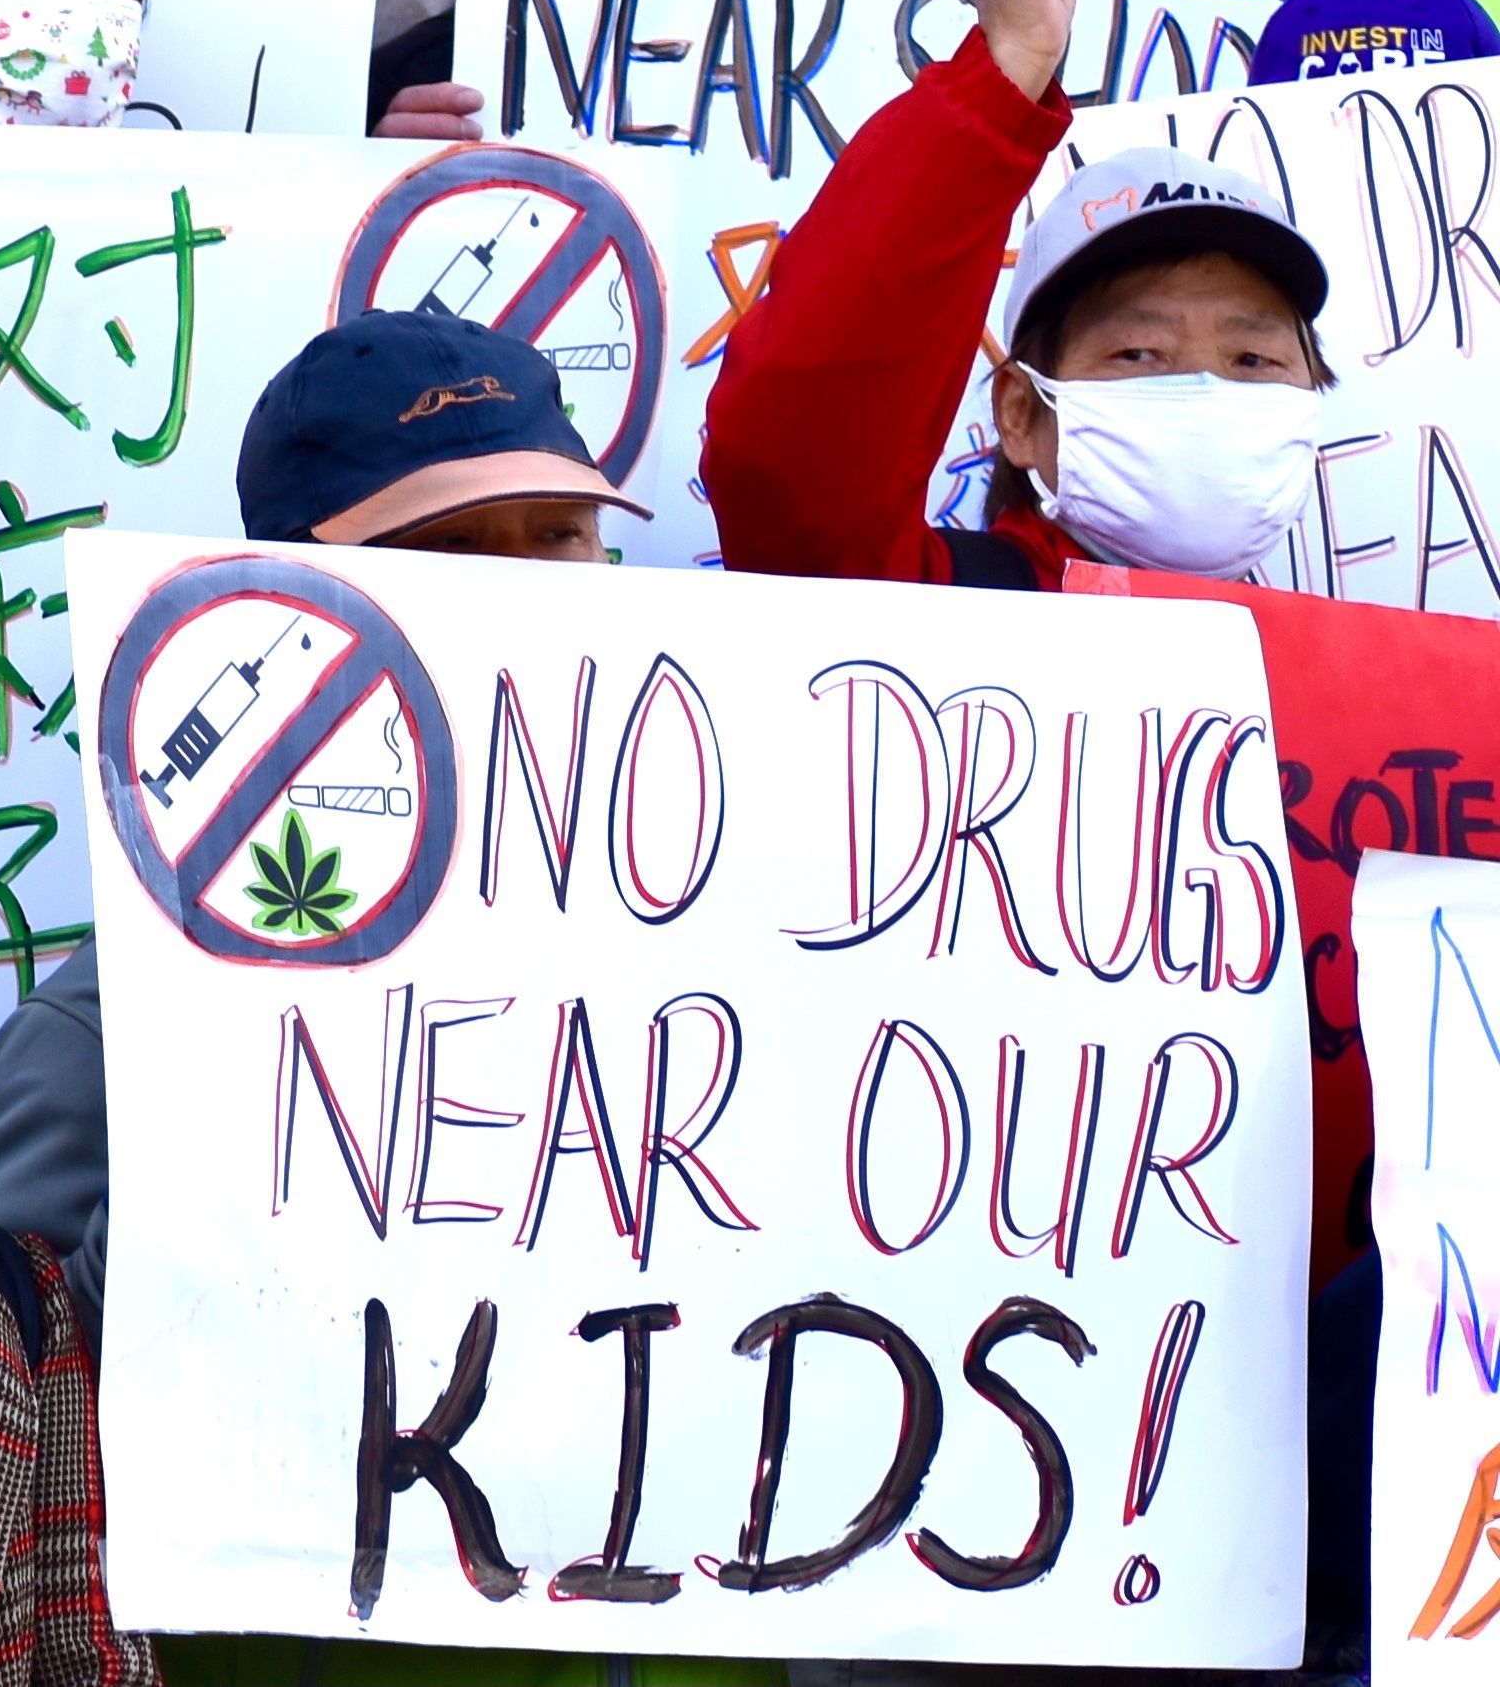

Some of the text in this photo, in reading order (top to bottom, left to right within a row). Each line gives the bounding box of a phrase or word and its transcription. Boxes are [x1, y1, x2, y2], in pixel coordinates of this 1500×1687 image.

[1301, 26, 1407, 56] INVEST
[480, 652, 1288, 994] NO DRUGS
[272, 984, 760, 1272] NEAR
[844, 1016, 1240, 1277] OUR
[350, 1290, 1208, 1620] KIDS!
